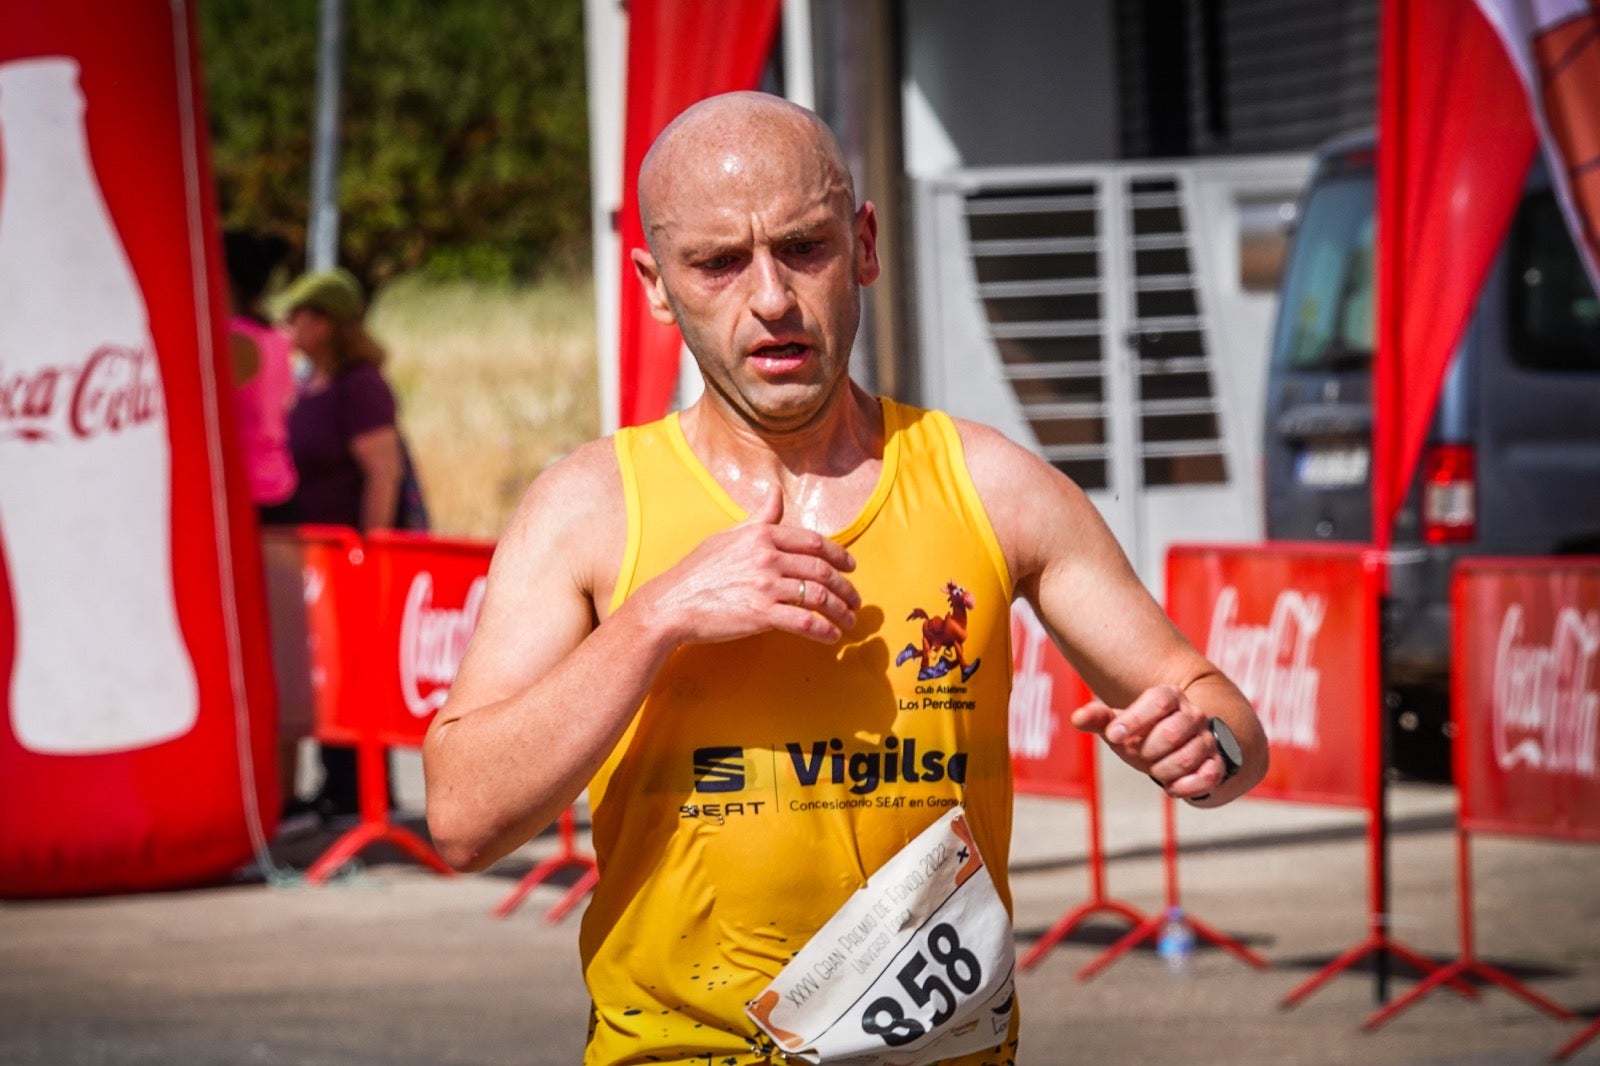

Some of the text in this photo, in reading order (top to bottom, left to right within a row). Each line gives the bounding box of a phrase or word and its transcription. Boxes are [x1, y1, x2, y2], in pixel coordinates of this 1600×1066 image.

[915, 685, 934, 695] Club
[899, 699, 919, 711] Los
[679, 801, 766, 819] SEAT
[789, 797, 873, 812] Concesionario
[876, 796, 906, 808] SEAT
[909, 798, 924, 807] en
[919, 843, 948, 878] 2022
[861, 922, 982, 1047] 858
